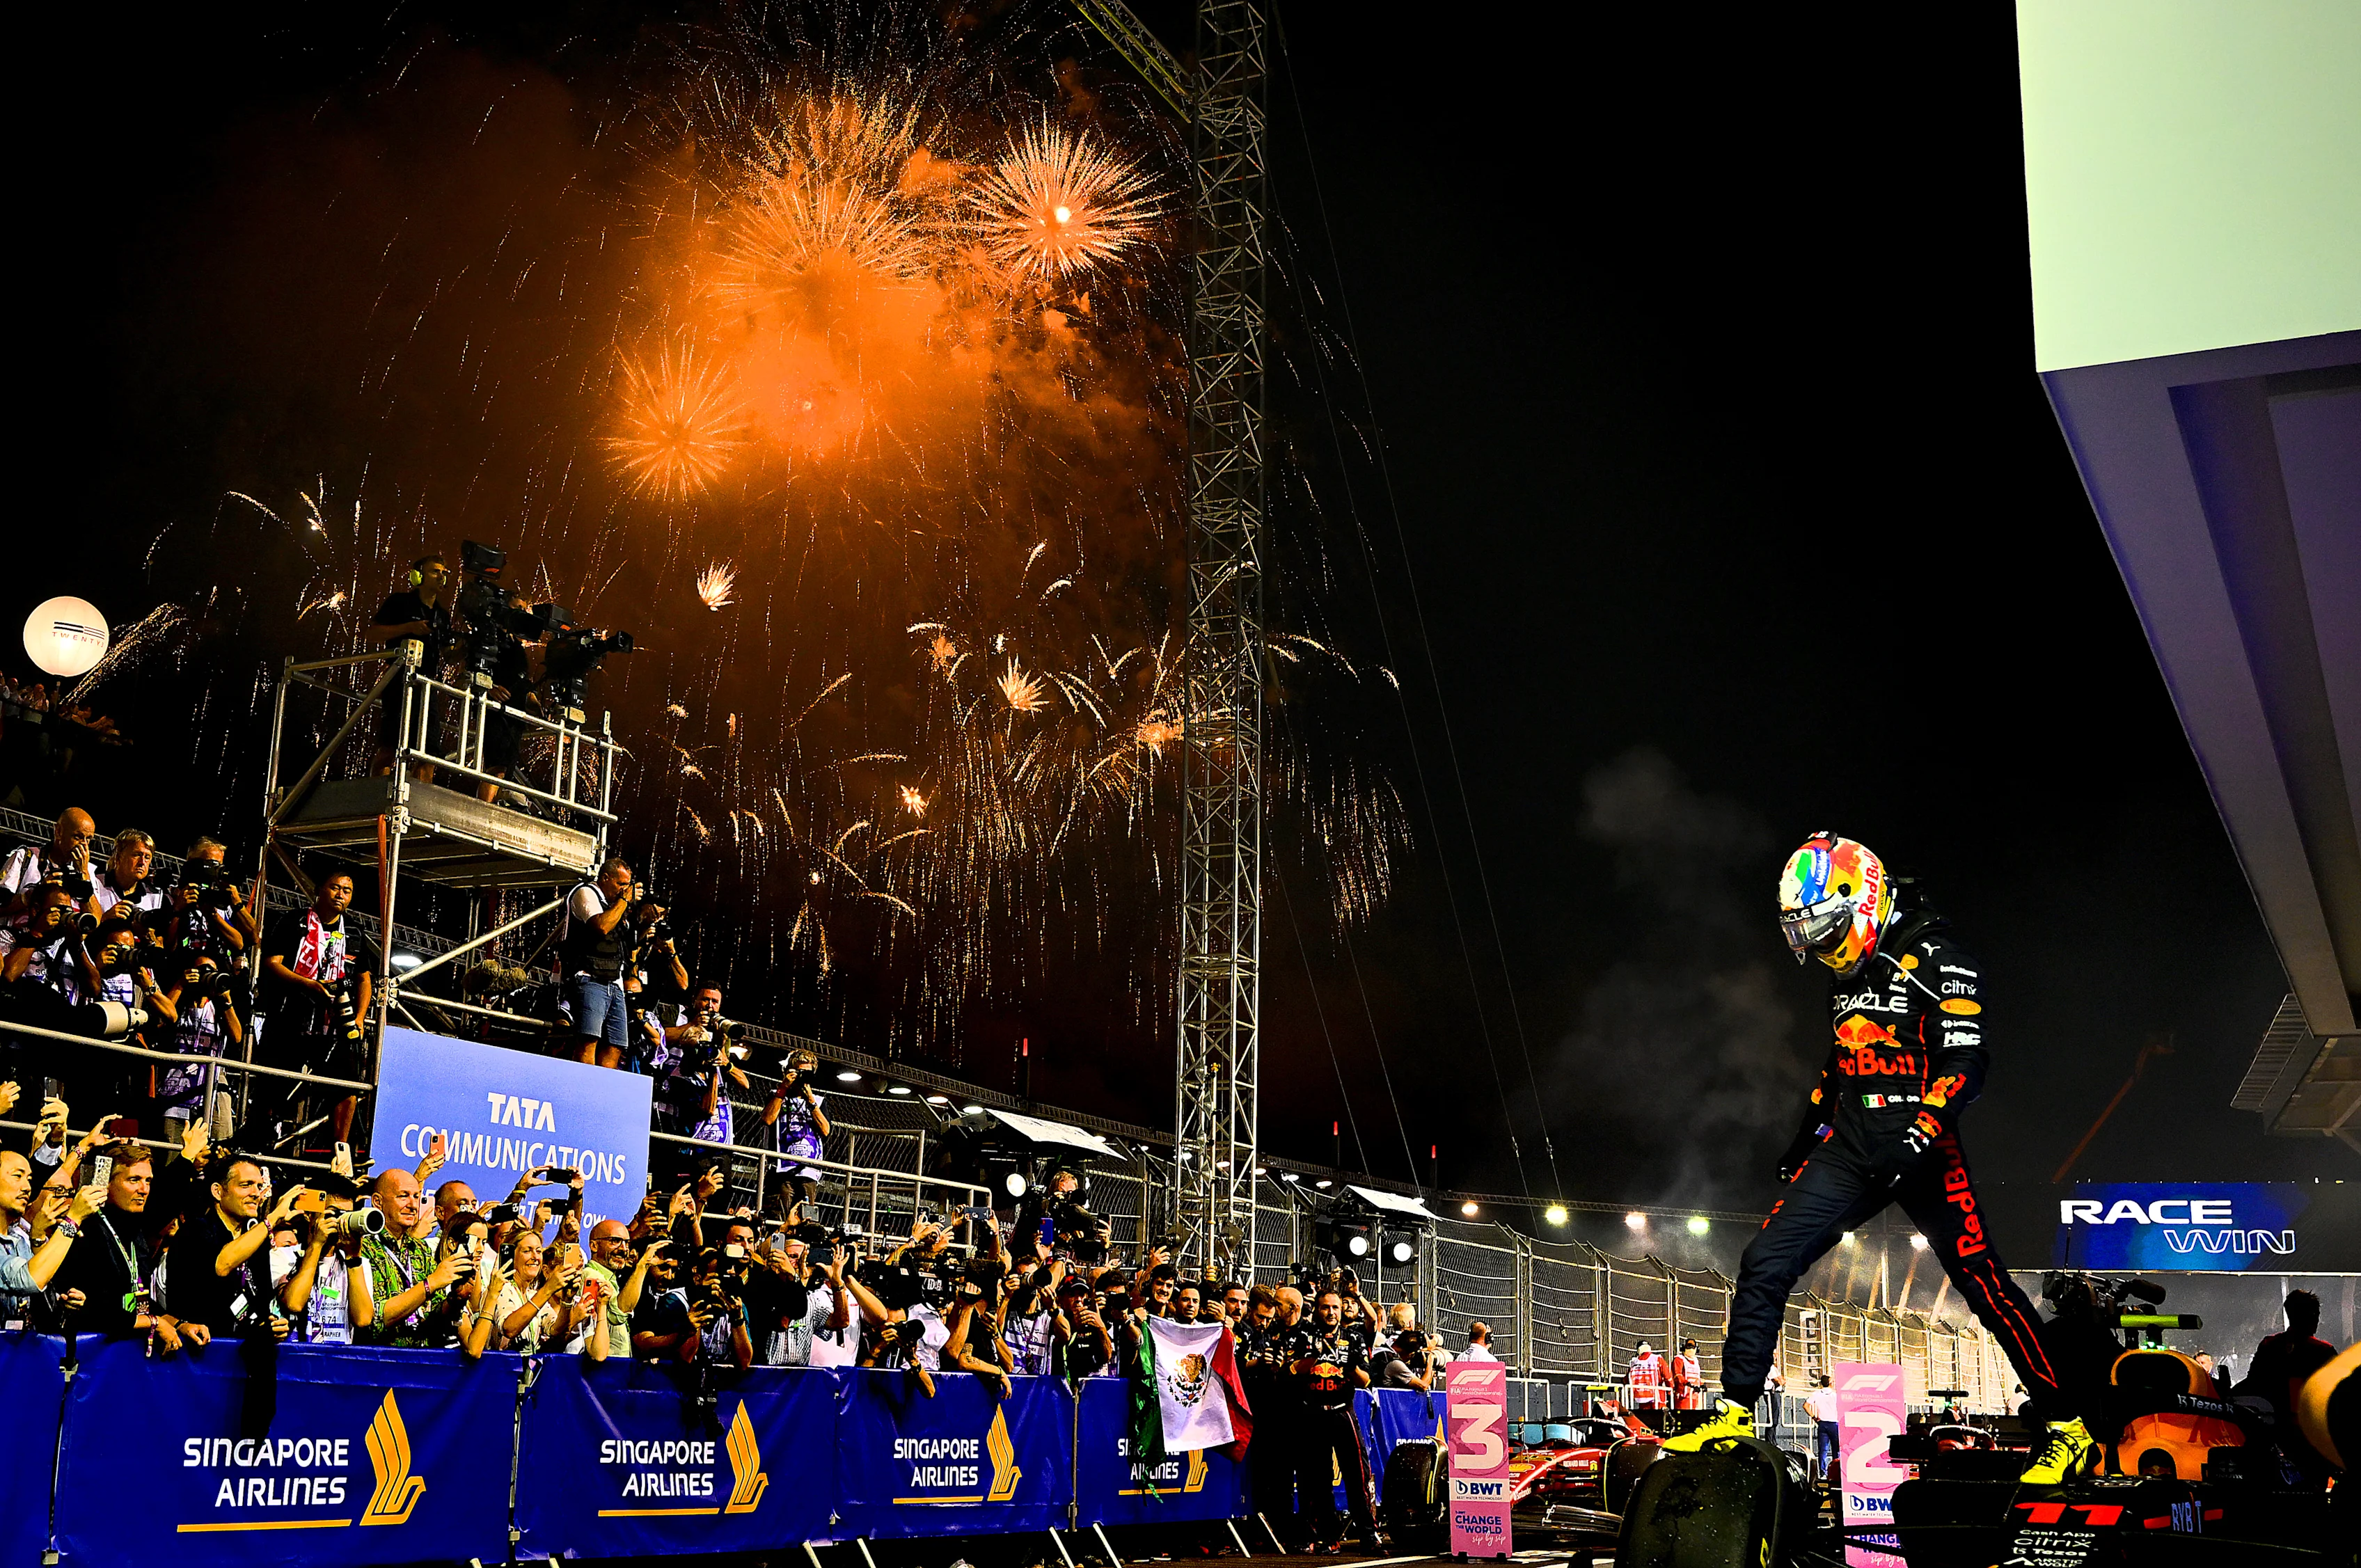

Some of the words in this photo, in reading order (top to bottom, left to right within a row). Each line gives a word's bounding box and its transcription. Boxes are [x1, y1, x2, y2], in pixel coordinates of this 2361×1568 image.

[487, 1092, 555, 1133] TATA
[400, 1123, 626, 1185] COMMUNICATIONS
[2060, 1199, 2233, 1226] RACE
[2163, 1229, 2296, 1255] WIN
[2190, 1397, 2222, 1411] Tezos
[893, 1439, 979, 1459] SINGAPORE
[1451, 1404, 1505, 1470] 3
[1845, 1411, 1903, 1483] 2
[183, 1438, 349, 1467] SINGAPORE
[599, 1439, 715, 1464] SINGAPORE
[622, 1473, 713, 1497] AIRLINES
[911, 1466, 978, 1487] AIRLINES
[215, 1477, 347, 1507] AIRLINES
[1470, 1482, 1503, 1496] BWT
[1867, 1498, 1893, 1511] BW
[2014, 1503, 2124, 1526] 11
[1455, 1516, 1502, 1525] CHANGE
[1465, 1526, 1502, 1534] WORLD
[1472, 1535, 1483, 1546] sip
[1485, 1531, 1494, 1546] by
[1495, 1535, 1506, 1545] sip
